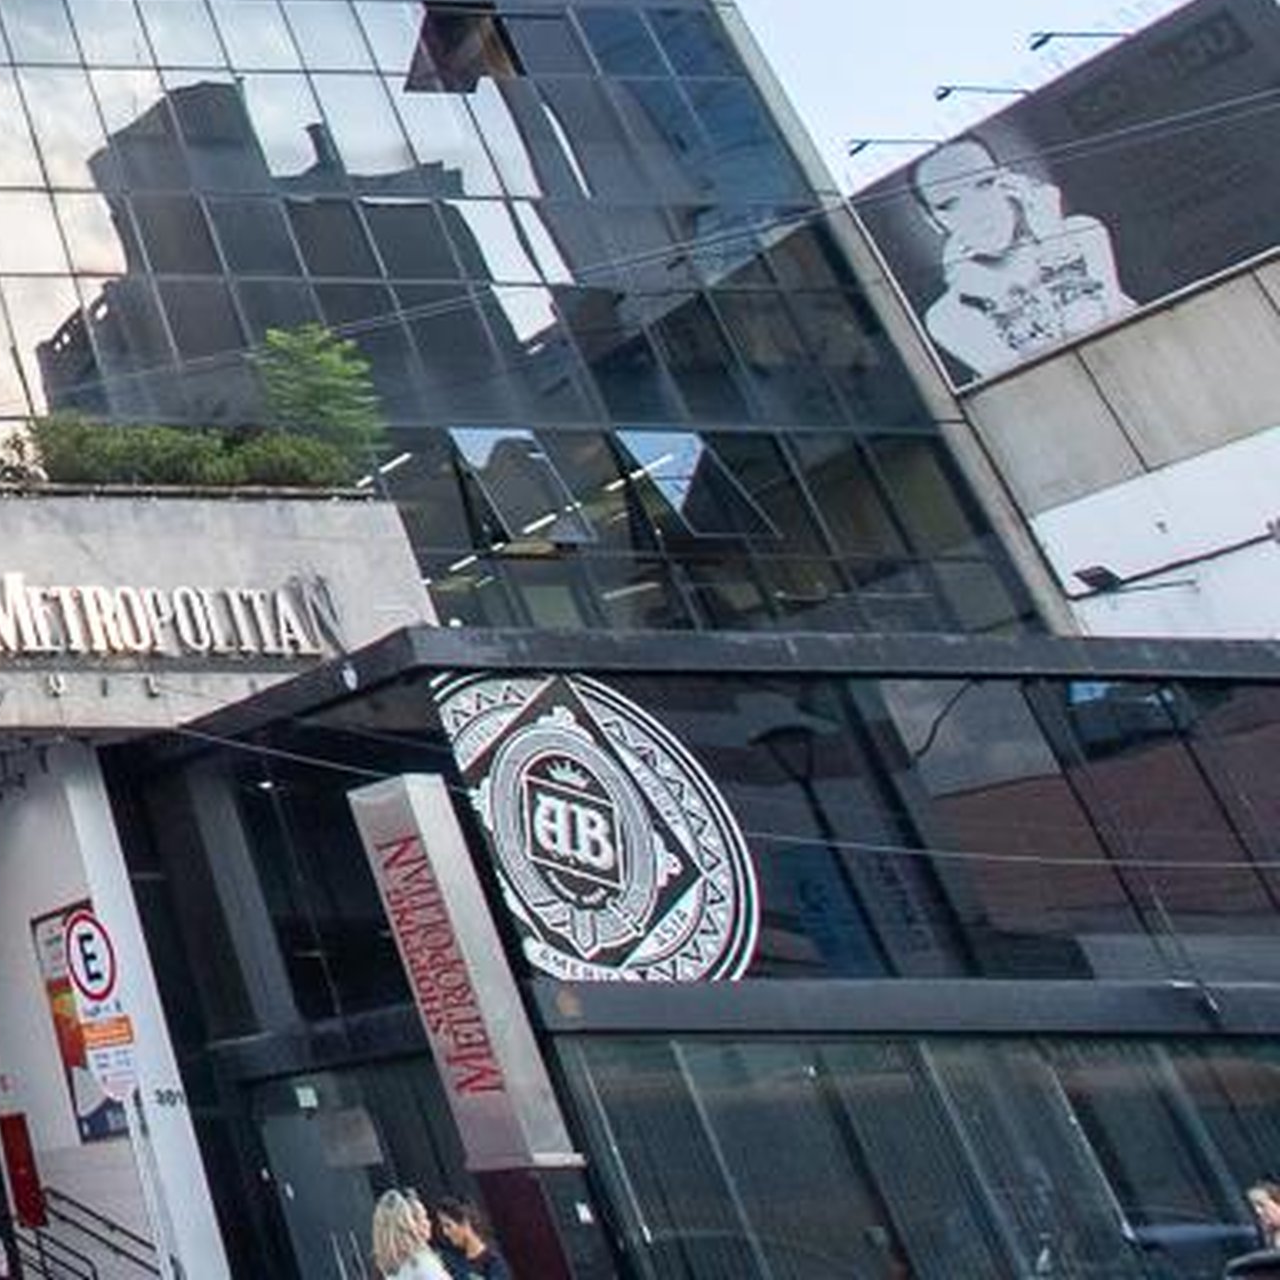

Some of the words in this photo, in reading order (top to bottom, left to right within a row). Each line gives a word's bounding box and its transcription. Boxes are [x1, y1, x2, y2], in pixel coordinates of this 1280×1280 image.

[77, 932, 104, 983] E
[374, 833, 506, 1097] METROPOLITAN
[387, 887, 445, 1035] SHOPPING
